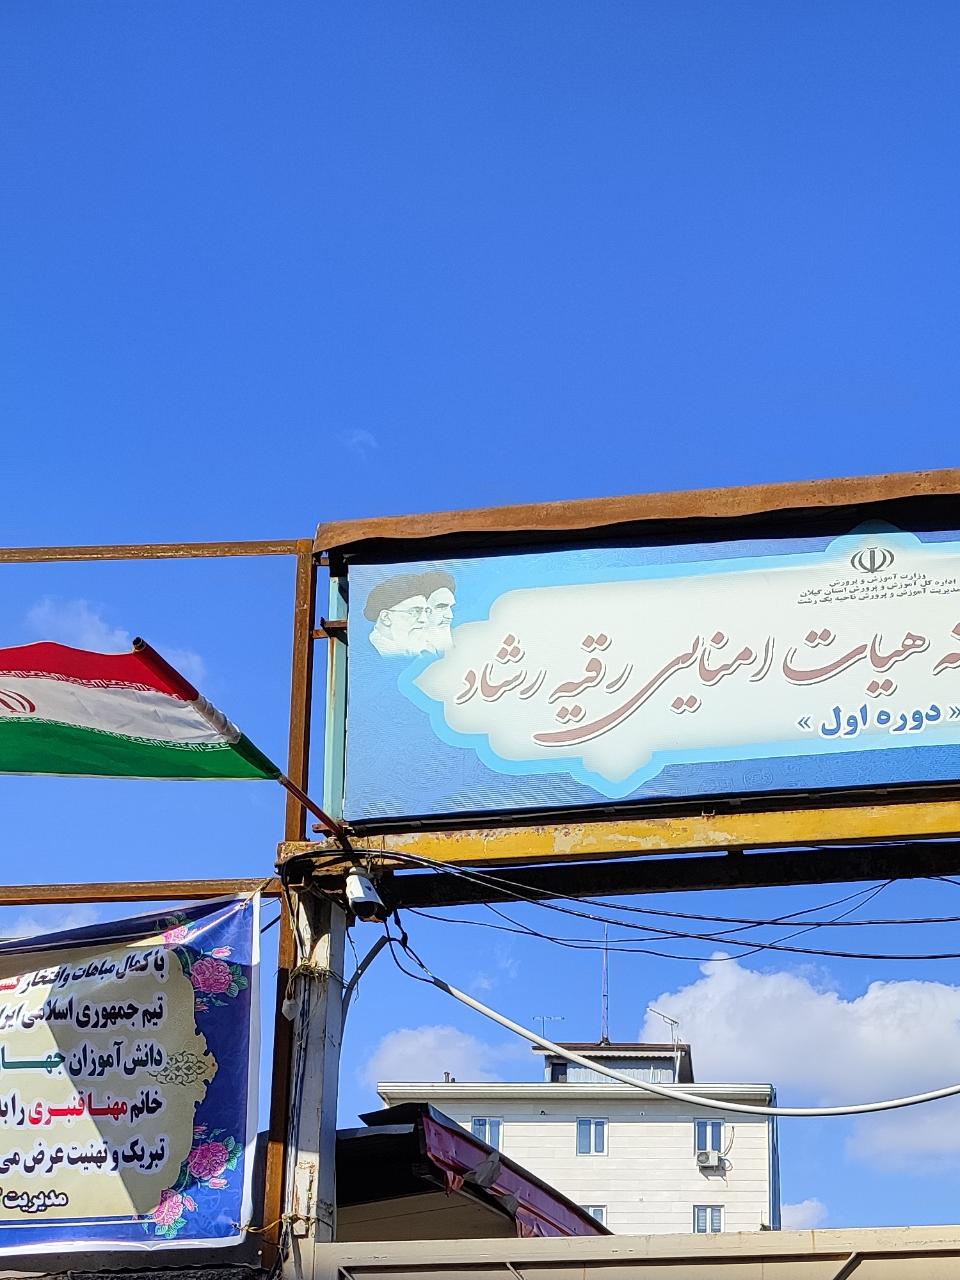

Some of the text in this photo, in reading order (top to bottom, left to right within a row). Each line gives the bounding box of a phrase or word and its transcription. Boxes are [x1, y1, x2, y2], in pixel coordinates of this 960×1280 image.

[455, 633, 547, 704] رشاد
[548, 633, 633, 723] رقیه
[72, 960, 114, 981] مباهات
[116, 950, 155, 979] کمال
[153, 948, 165, 978] با
[22, 997, 73, 1029] اسلامی
[75, 1003, 139, 1029] جمهوری
[141, 997, 164, 1028] تیم
[69, 1041, 123, 1077] آموزان
[124, 1044, 163, 1075] دانش
[11, 1093, 25, 1126] را
[29, 1090, 84, 1125] قنبری
[131, 1090, 163, 1123] خانم
[24, 1142, 64, 1173] عرض
[67, 1141, 108, 1171] تهنیت
[122, 1139, 165, 1170] تبریک
[2, 1190, 69, 1212] مدیریت
